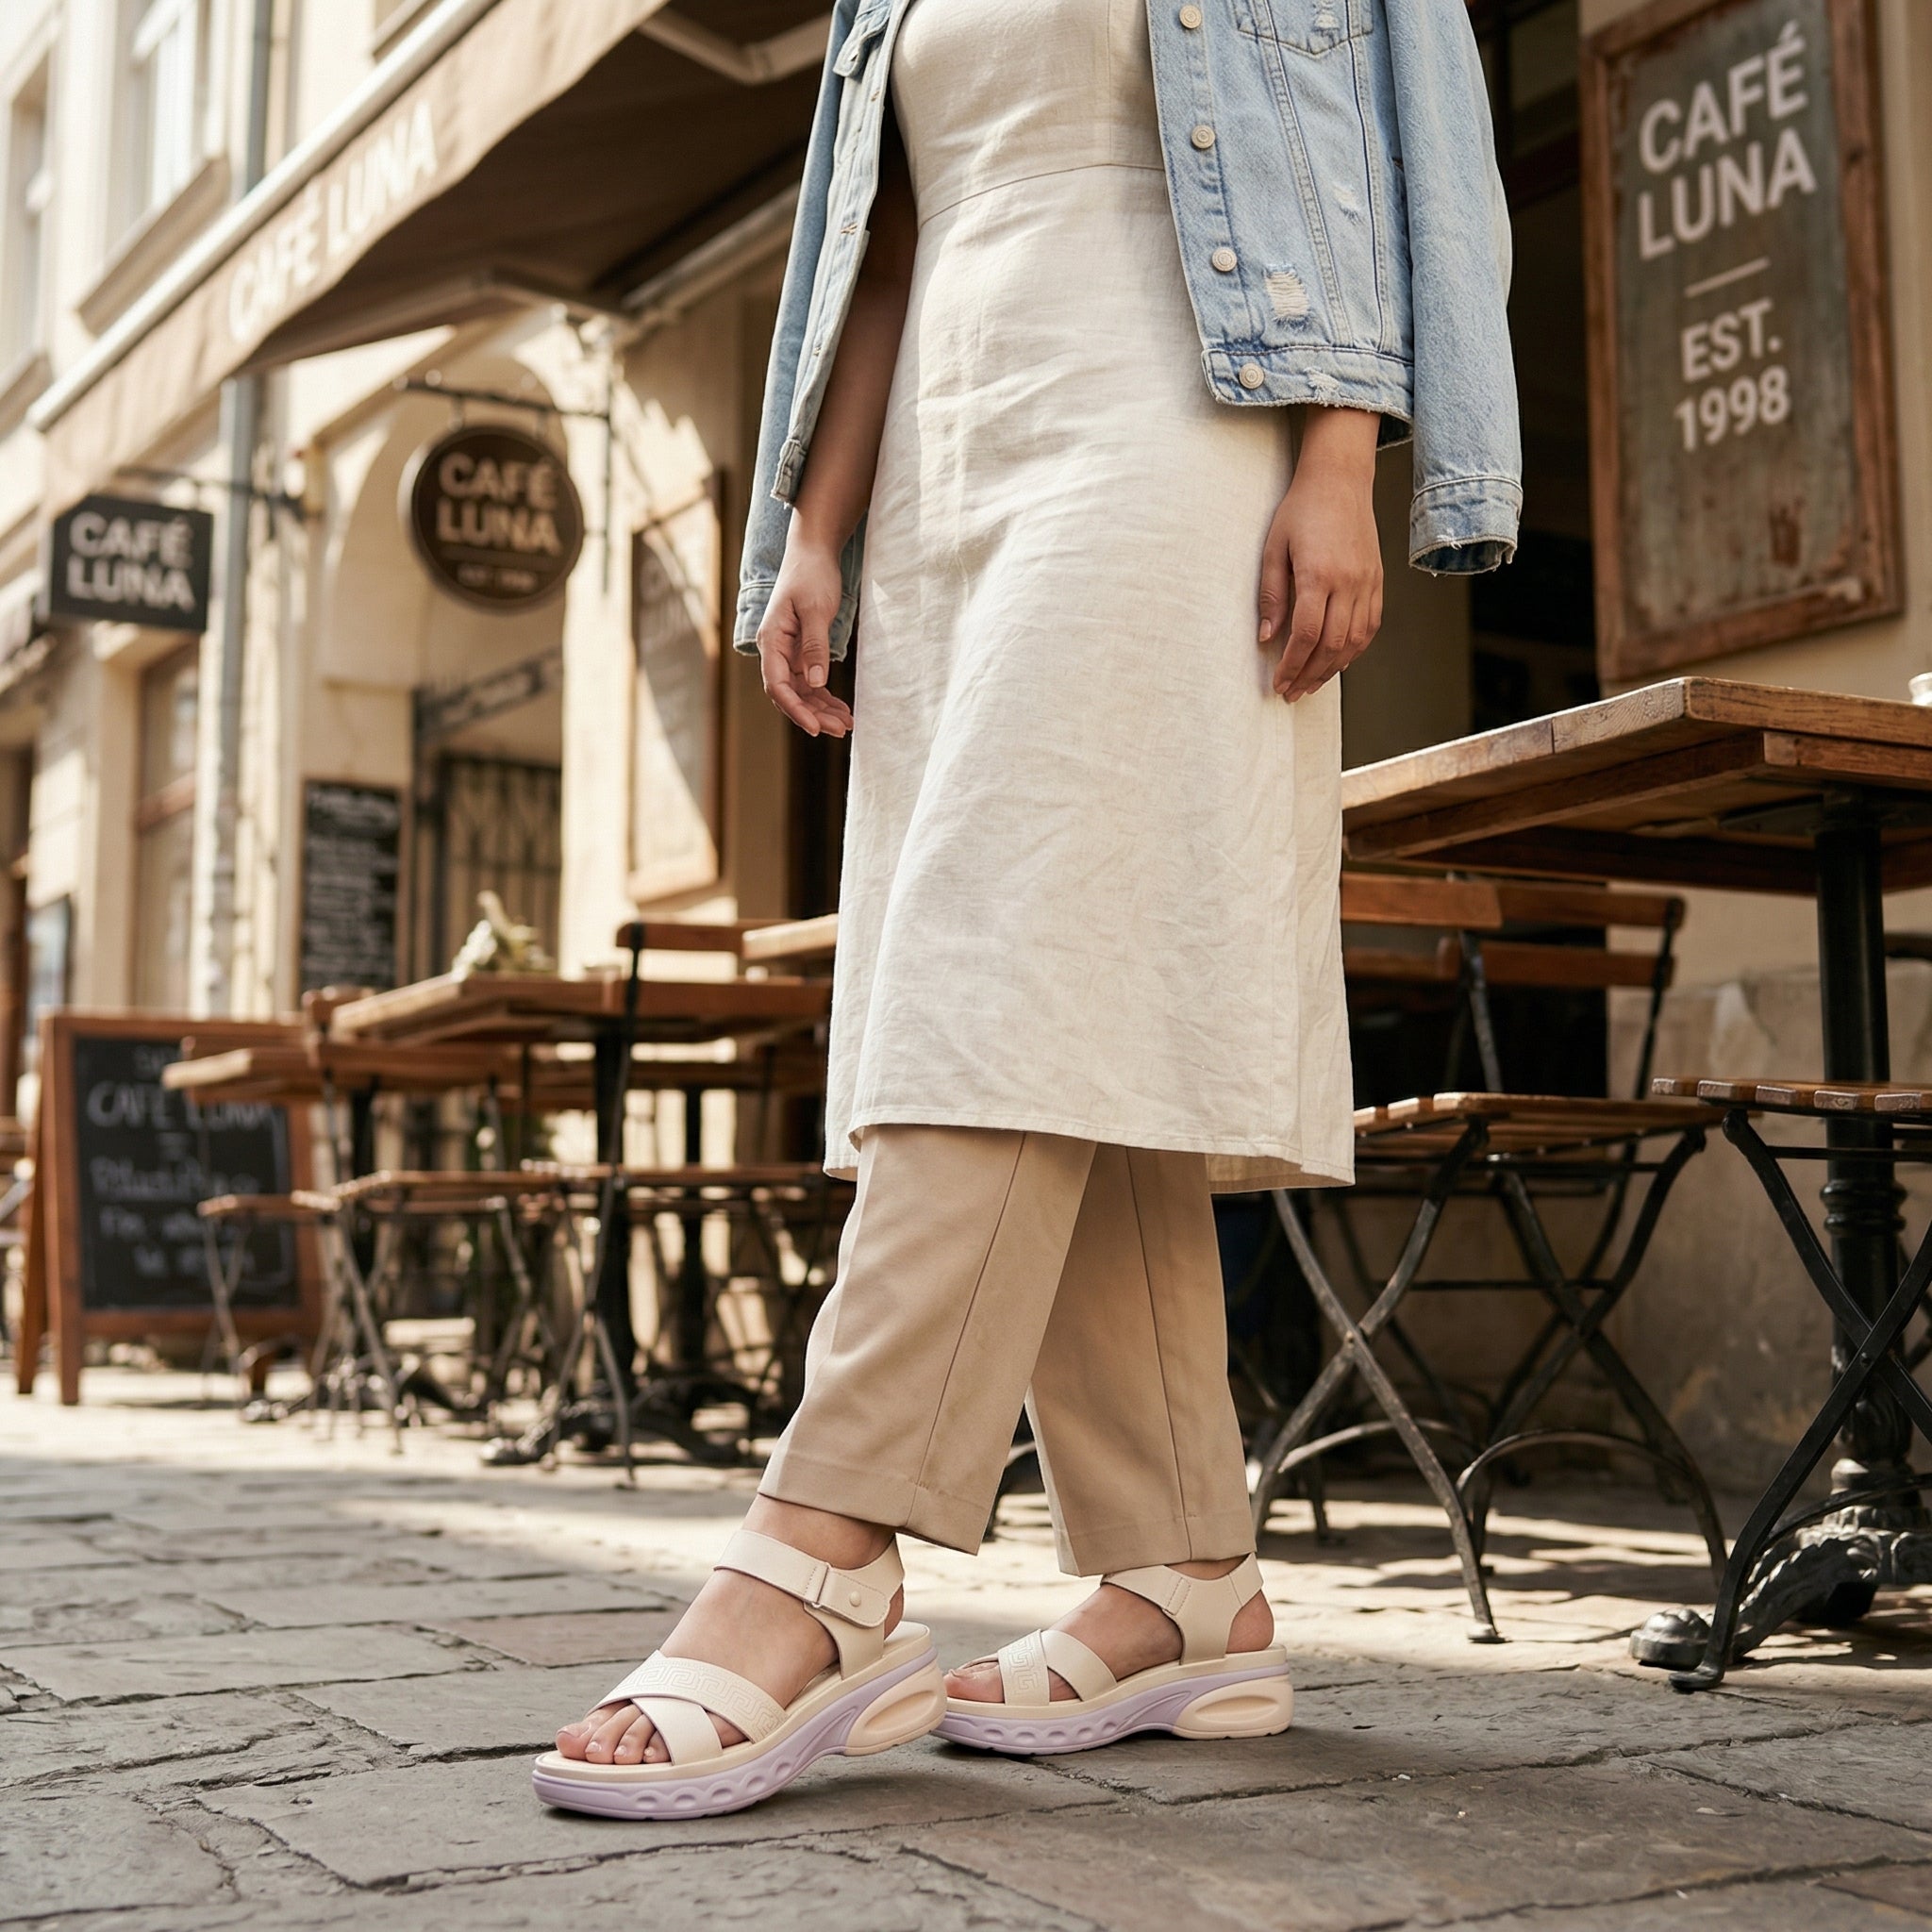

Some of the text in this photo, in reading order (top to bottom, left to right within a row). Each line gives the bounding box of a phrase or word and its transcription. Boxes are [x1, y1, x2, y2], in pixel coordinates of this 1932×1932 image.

[1639, 21, 1807, 174] CAFÉ
[326, 100, 437, 258] LUNA
[1639, 128, 1818, 260] LUNA
[1681, 298, 1782, 384] EST.
[1674, 366, 1790, 452] 1998
[439, 452, 558, 510] CAFÉ
[69, 511, 193, 566] CAFÉ
[437, 496, 563, 557] LUNA
[66, 554, 196, 613] LUNA
